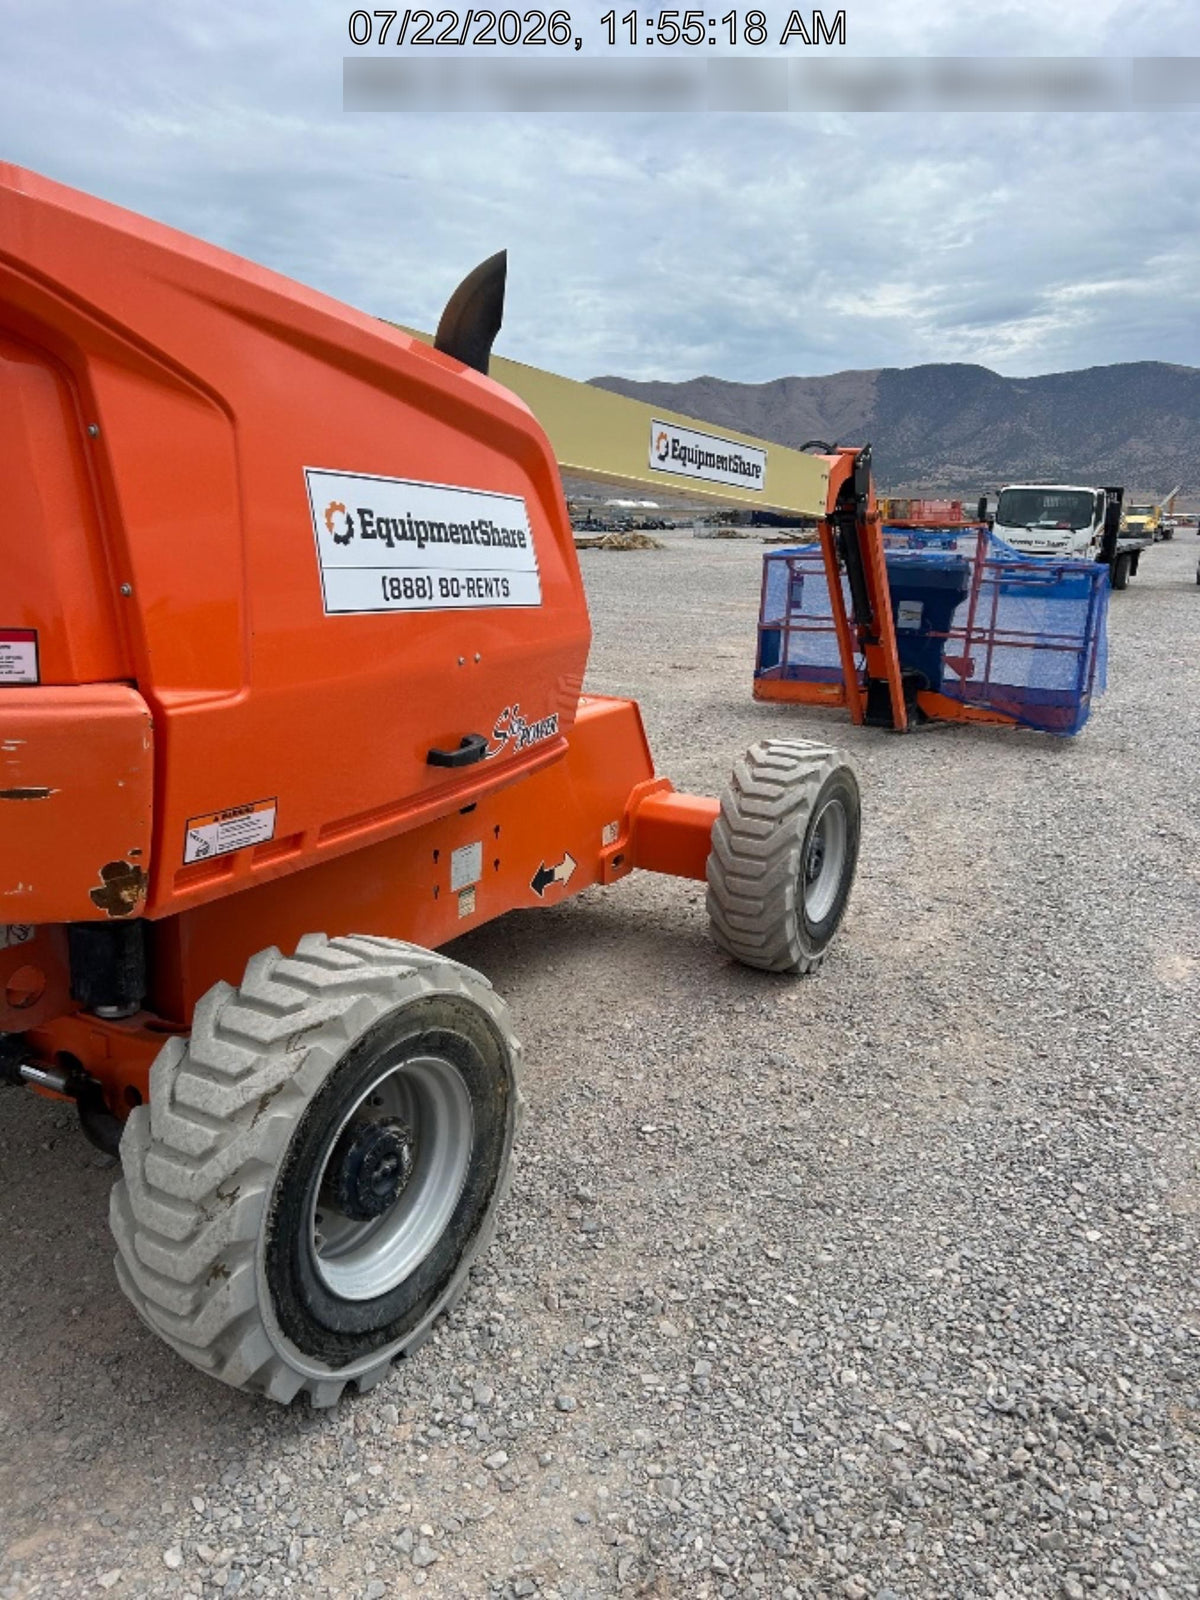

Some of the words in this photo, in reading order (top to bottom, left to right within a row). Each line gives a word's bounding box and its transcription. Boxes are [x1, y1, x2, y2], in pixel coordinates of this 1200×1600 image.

[671, 437, 762, 479] EquipmentShare
[357, 508, 527, 549] EquipmentShare
[381, 575, 433, 601] (888)
[438, 576, 510, 599] 80-RENTS
